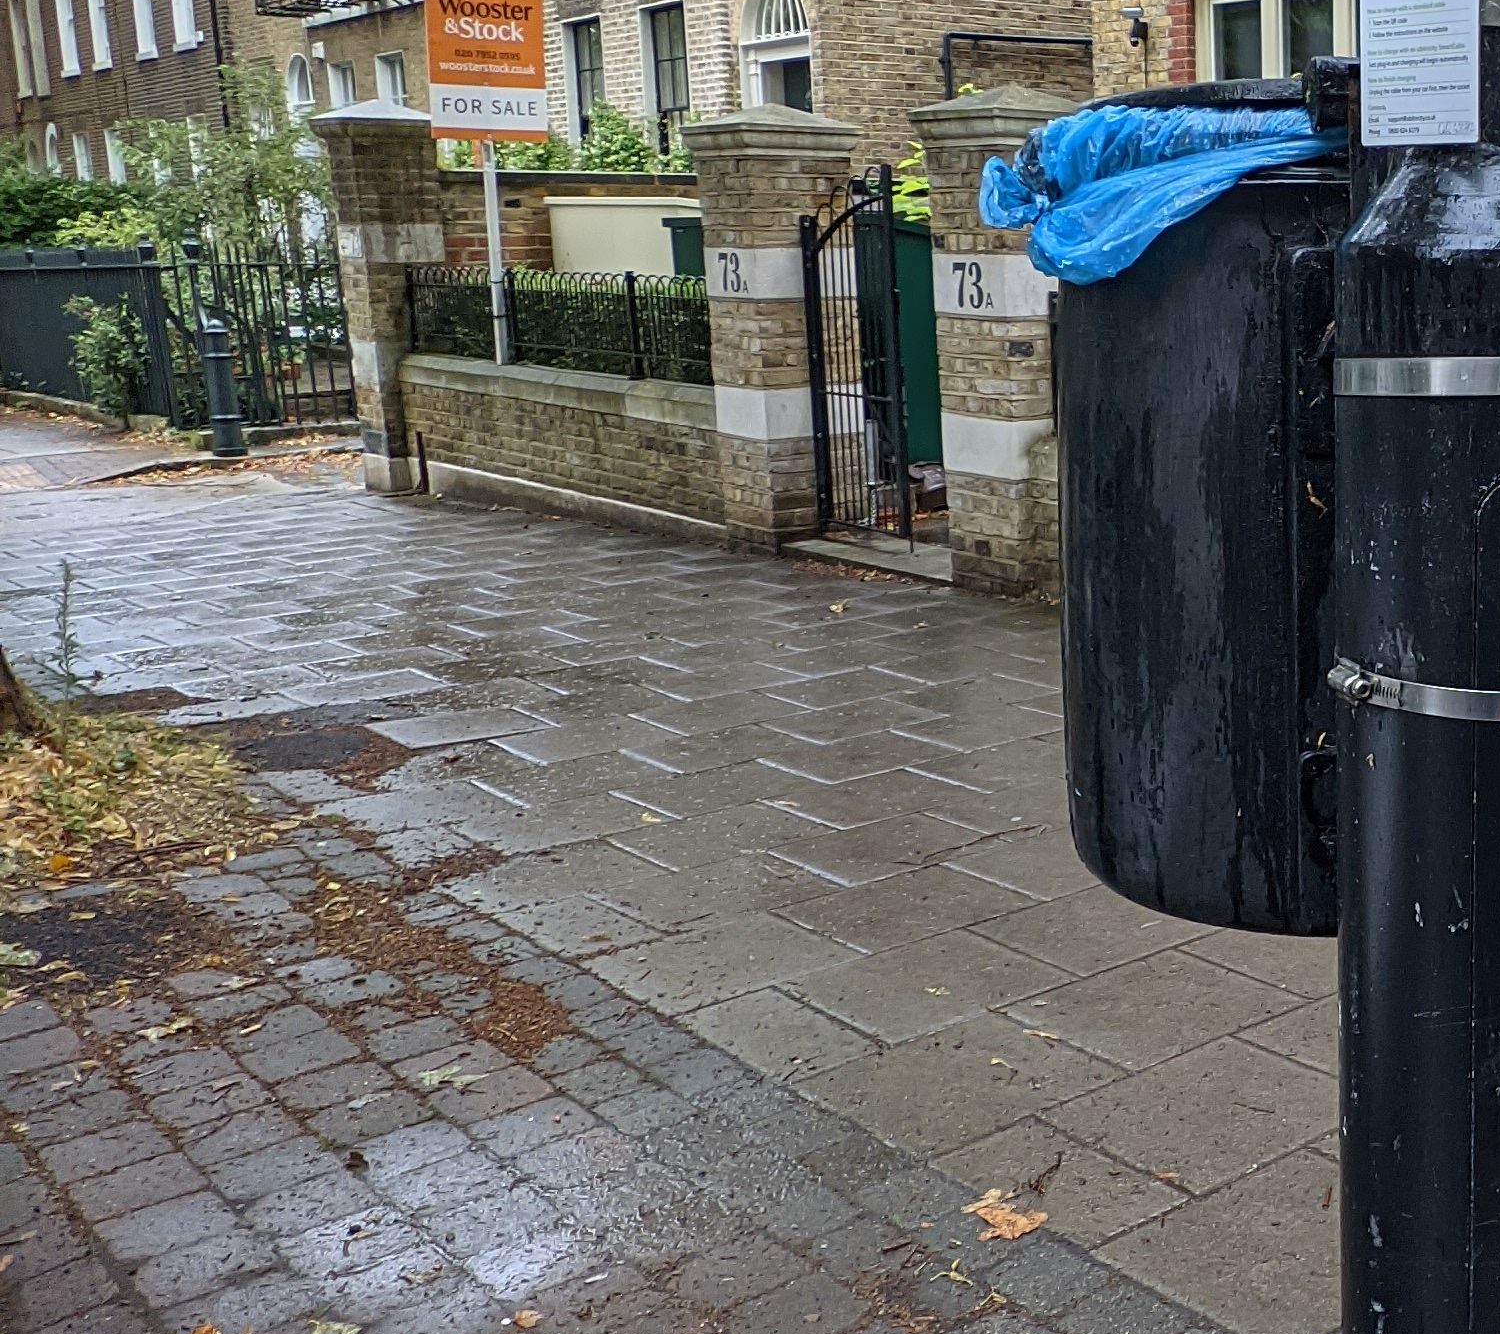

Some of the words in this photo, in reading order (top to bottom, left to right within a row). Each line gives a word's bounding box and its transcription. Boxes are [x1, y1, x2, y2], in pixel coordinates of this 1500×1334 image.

[441, 97, 483, 114] FOR
[491, 99, 538, 117] SALE
[717, 251, 749, 294] 73A
[951, 261, 993, 310] 73A
